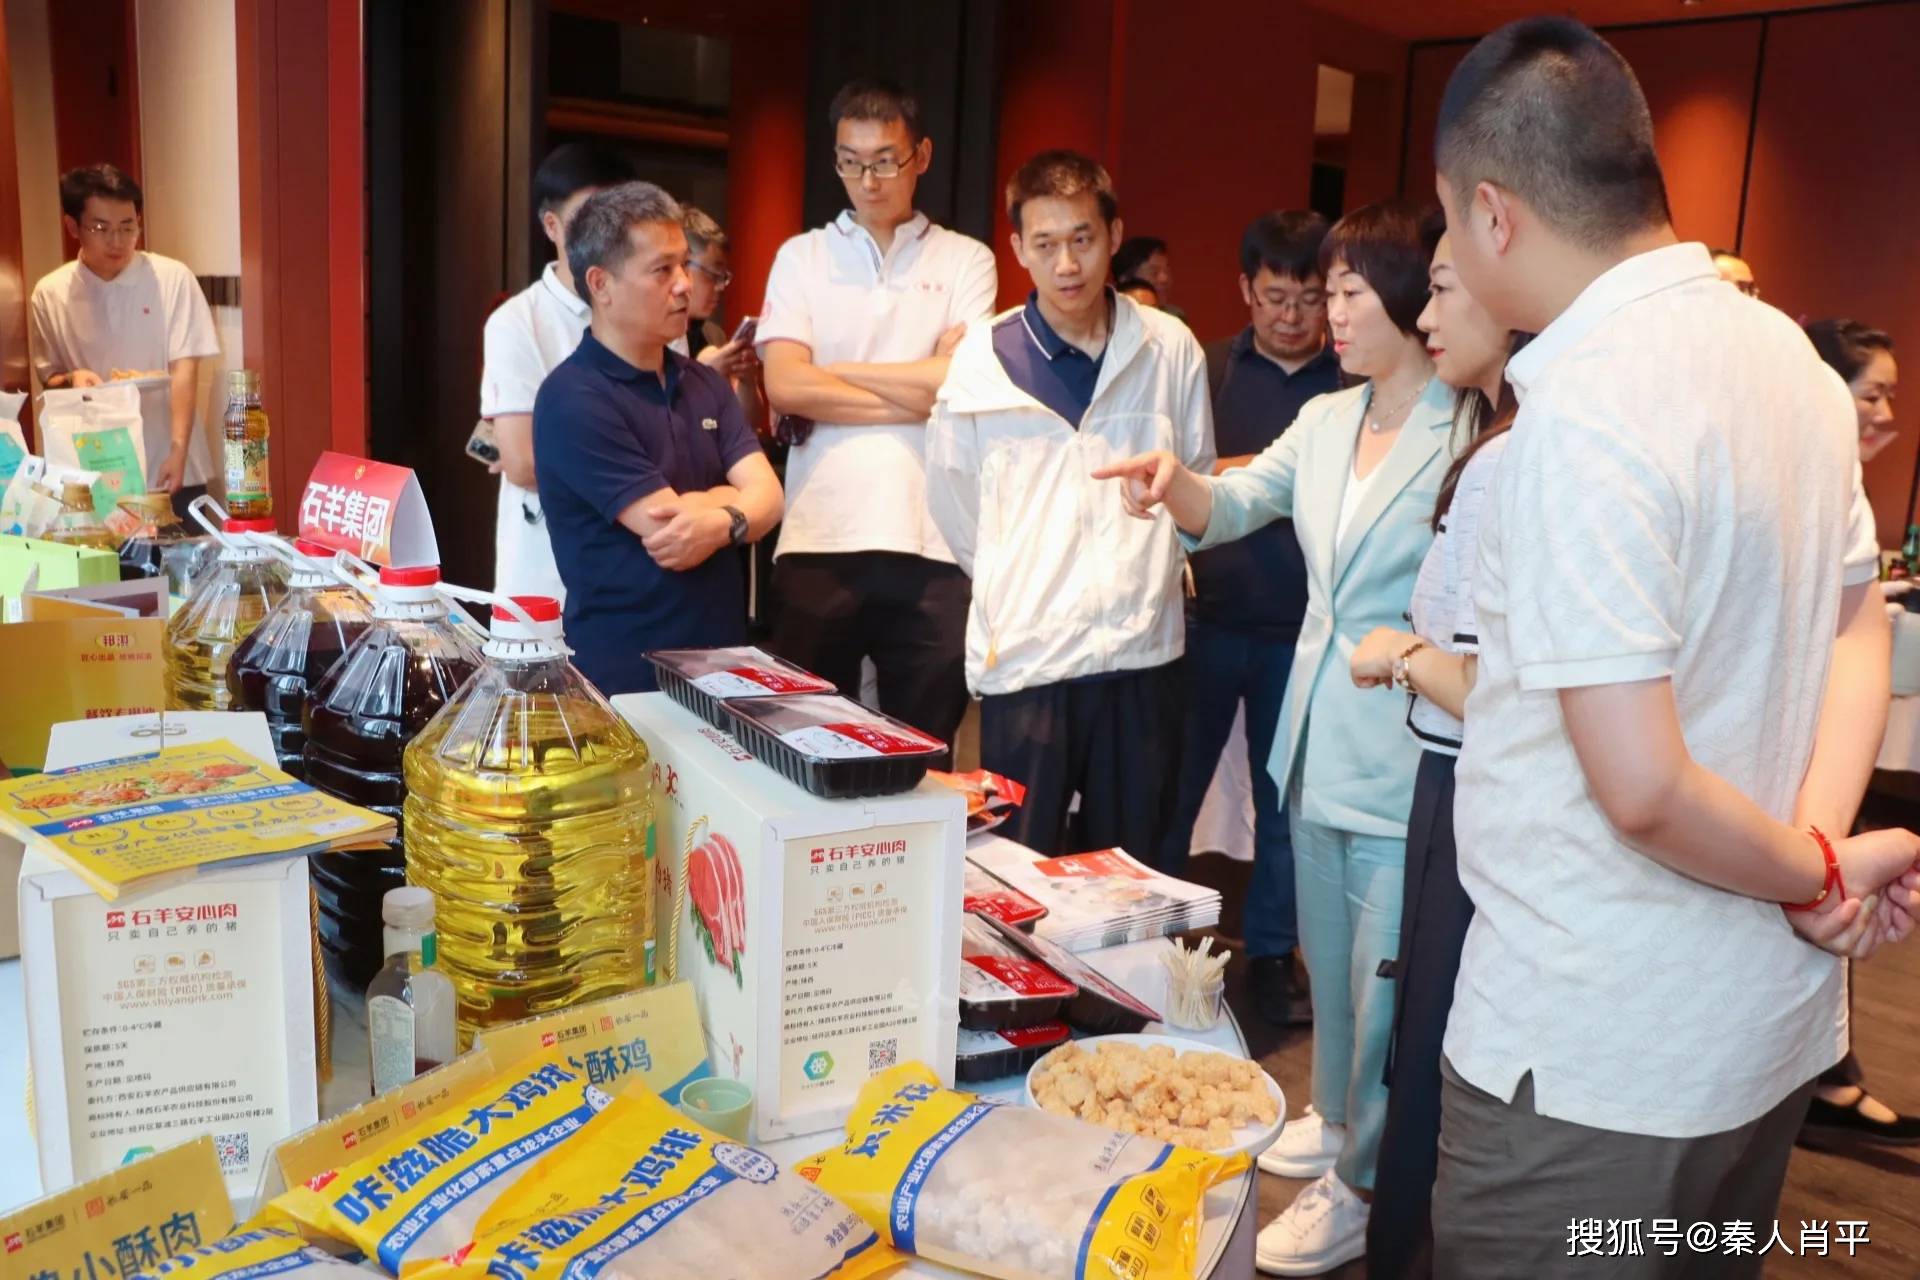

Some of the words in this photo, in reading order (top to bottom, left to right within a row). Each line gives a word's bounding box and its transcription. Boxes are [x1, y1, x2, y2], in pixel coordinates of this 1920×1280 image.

[302, 482, 391, 547] 石羊集团
[829, 839, 906, 861] 石羊安心肉
[131, 903, 238, 926] 石羊安心肉
[107, 921, 238, 942] 只卖自己养的猪
[557, 1024, 588, 1040] 石羊集团
[568, 1037, 652, 1084] 酥鸡
[357, 1116, 390, 1137] 石羊集团
[333, 1062, 577, 1226] 咔滋脆大鸡排
[385, 1116, 582, 1251] 农业产业化国家重点龙头企业
